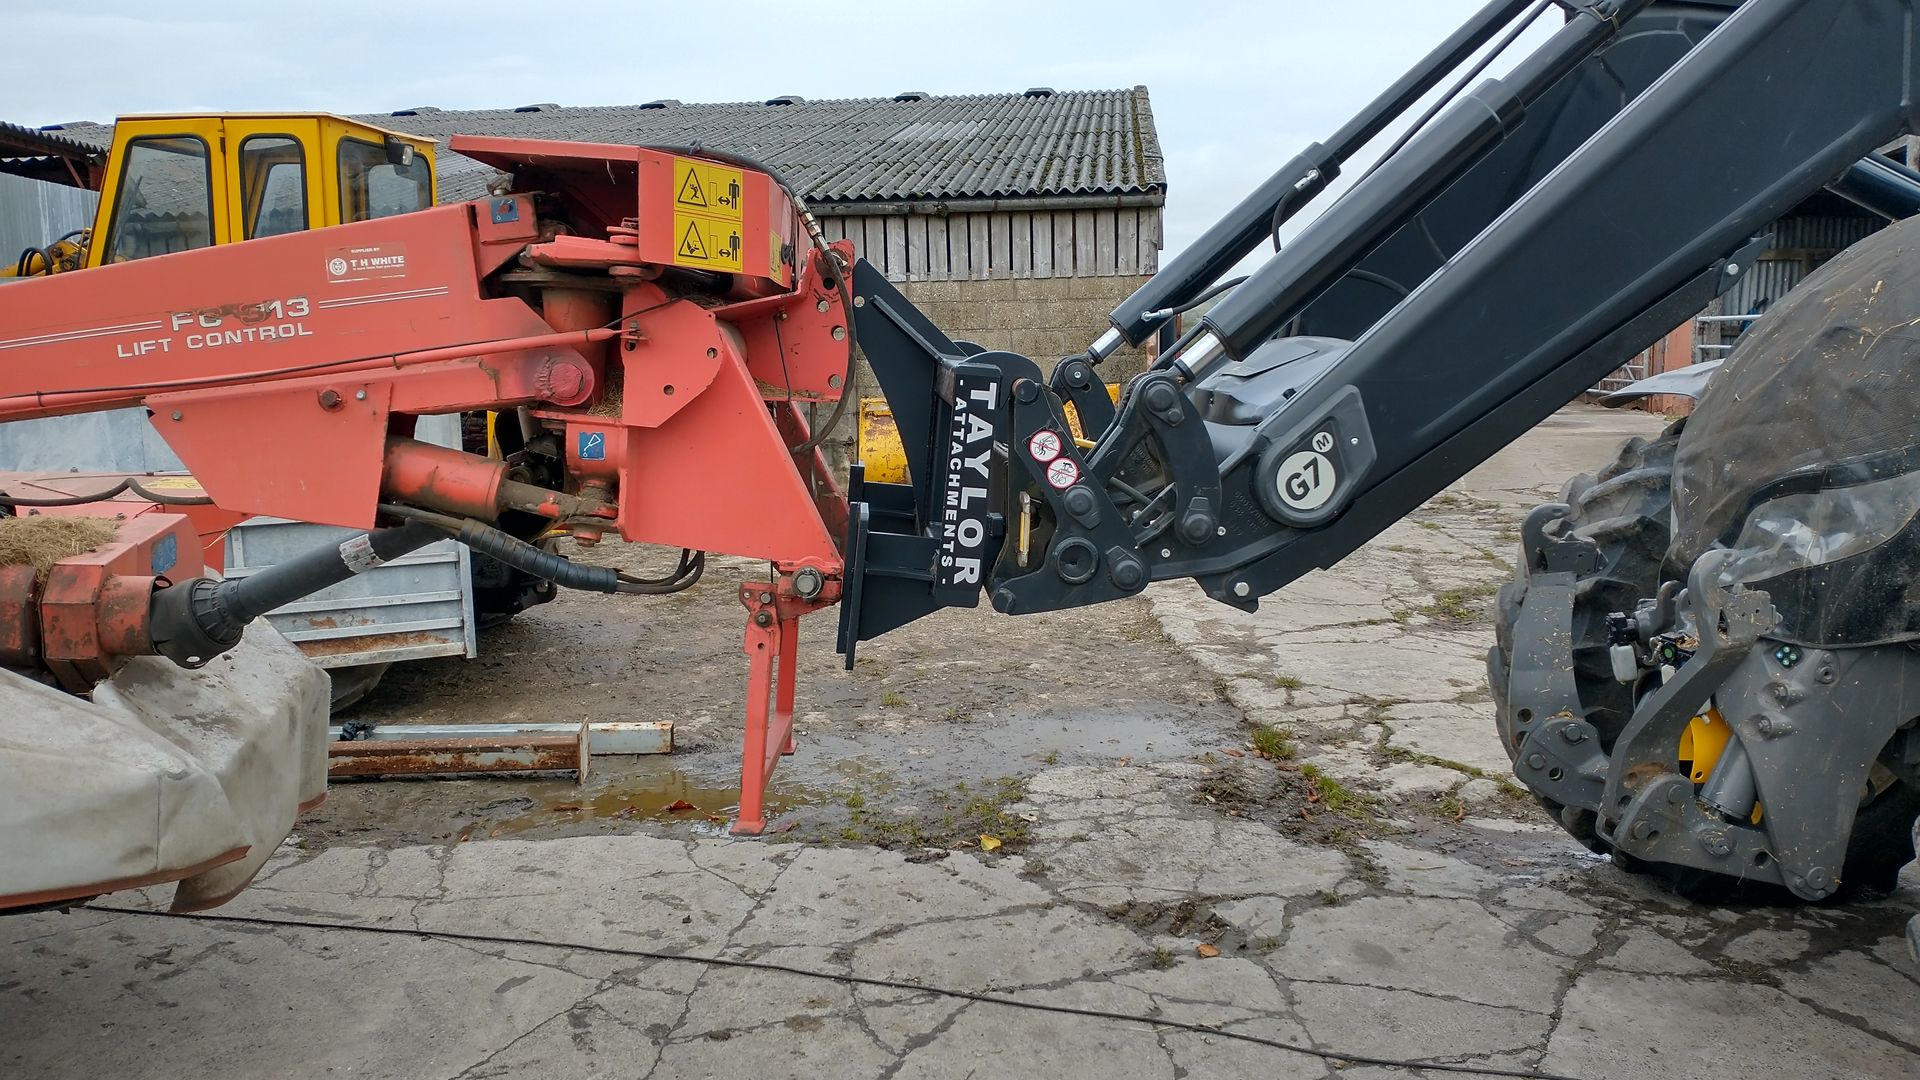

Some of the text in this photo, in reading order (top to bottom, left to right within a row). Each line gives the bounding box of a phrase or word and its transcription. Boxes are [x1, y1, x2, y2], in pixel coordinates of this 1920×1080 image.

[350, 259, 358, 267] T
[360, 258, 368, 266] H
[370, 256, 405, 266] WHITE
[117, 322, 313, 358] LIFT CONTROL
[1316, 434, 1330, 451] M
[941, 396, 968, 568] ATTACHMENTS
[953, 382, 997, 585] TAYLOR
[1285, 456, 1320, 501] G7
